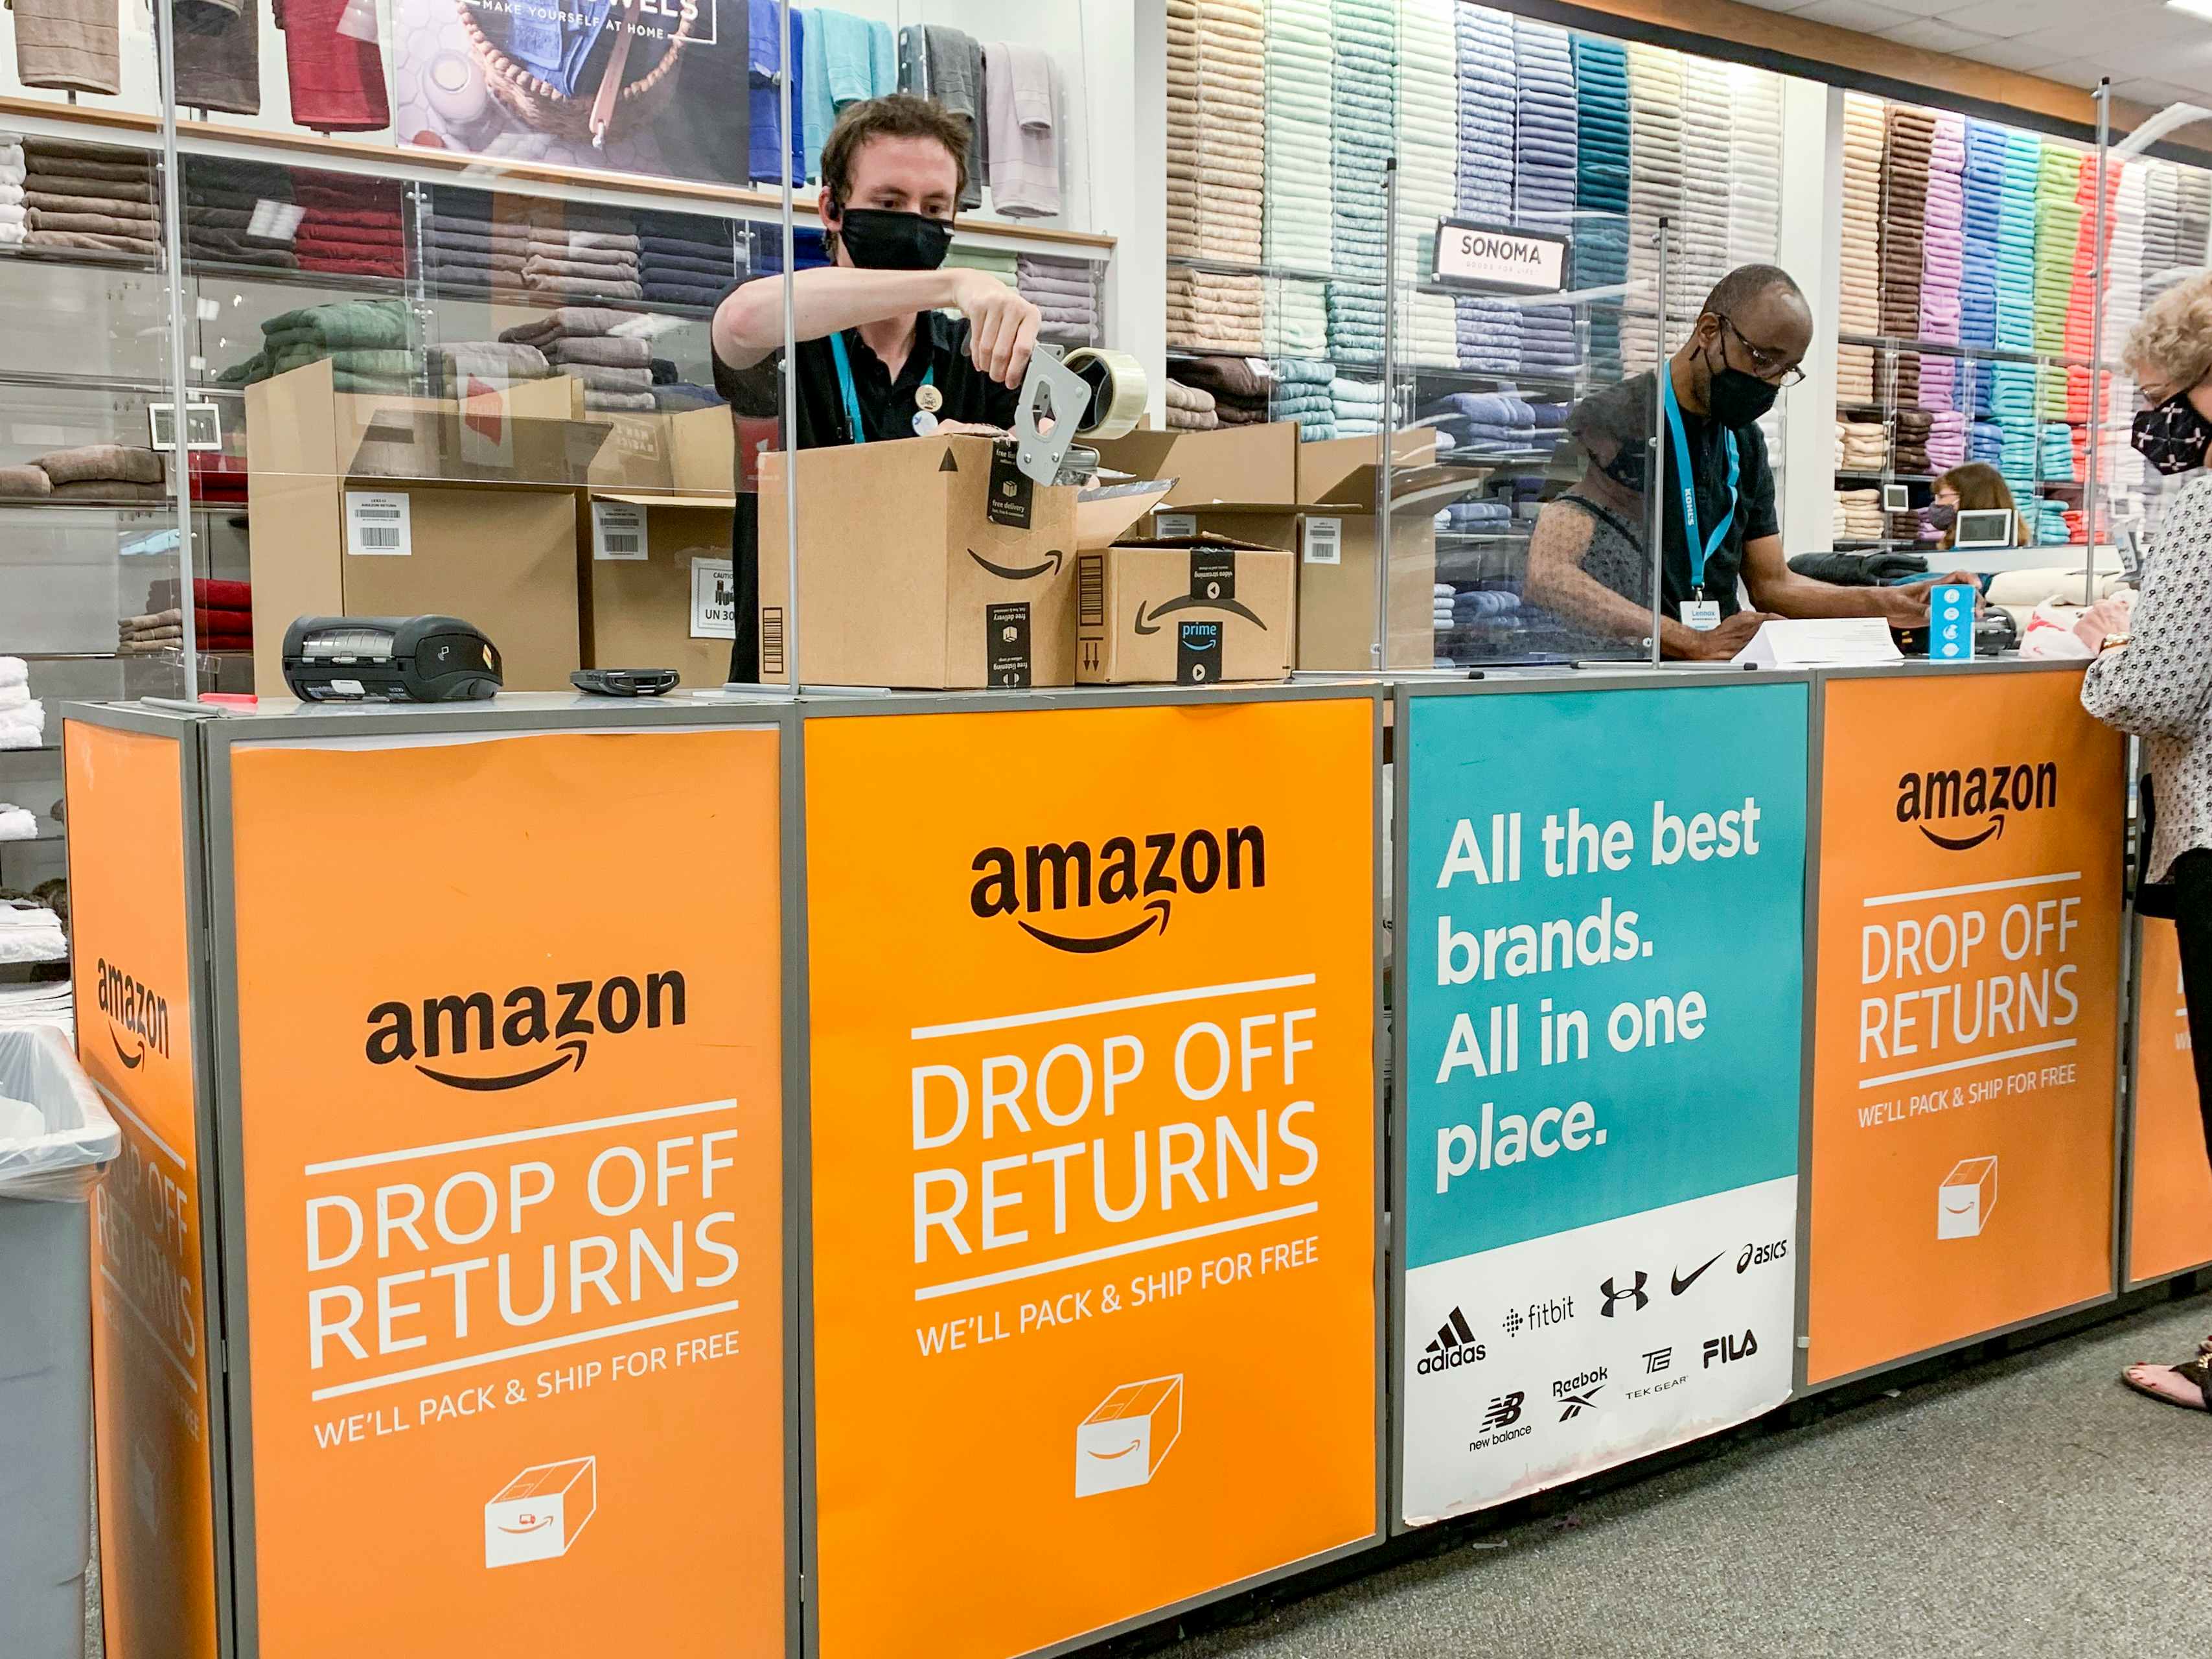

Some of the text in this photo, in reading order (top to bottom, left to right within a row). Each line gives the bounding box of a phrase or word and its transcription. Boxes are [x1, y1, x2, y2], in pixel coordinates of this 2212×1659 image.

[483, 2, 664, 39] MAKE YOURSELF AT HOME
[1461, 235, 1541, 264] SONOMA
[996, 448, 1007, 458] free
[992, 500, 1003, 508] free
[1004, 502, 1025, 513] delivery
[706, 609, 720, 620] UN
[1182, 621, 1217, 638] prime
[993, 662, 1016, 671] listening
[1896, 761, 2056, 822] amazon
[971, 824, 1265, 918] amazon
[1436, 796, 1760, 888] All the best
[1437, 897, 1653, 986] brands.
[1861, 897, 2081, 984] DROP OFF
[98, 958, 169, 1059] amazon
[365, 970, 686, 1065] amazon
[1435, 990, 1707, 1084] All in one
[1860, 965, 2079, 1063] RETURNS
[912, 1008, 1317, 1150] DROP OFF
[1858, 1063, 2077, 1128] WE'LL PACK & SHIP FOR FREE
[914, 1101, 1319, 1264] RETURNS
[1436, 1101, 1607, 1194] place.
[148, 1162, 187, 1257] OFF
[306, 1129, 738, 1272] DROP OFF
[1754, 1239, 1787, 1264] asics
[308, 1212, 740, 1369] RETURNS
[916, 1236, 1319, 1356] WE'LL PACK & SHIP FOR FREE
[1528, 1295, 1574, 1330] fitbit
[1417, 1344, 1486, 1375] adidas
[1552, 1366, 1608, 1397] Reebok
[1703, 1328, 1758, 1369] FILA
[314, 1330, 740, 1448] WE'LL PACK & SHIP FOR FREE
[1626, 1376, 1689, 1400] TEK GEAR
[1469, 1425, 1532, 1452] new balance
